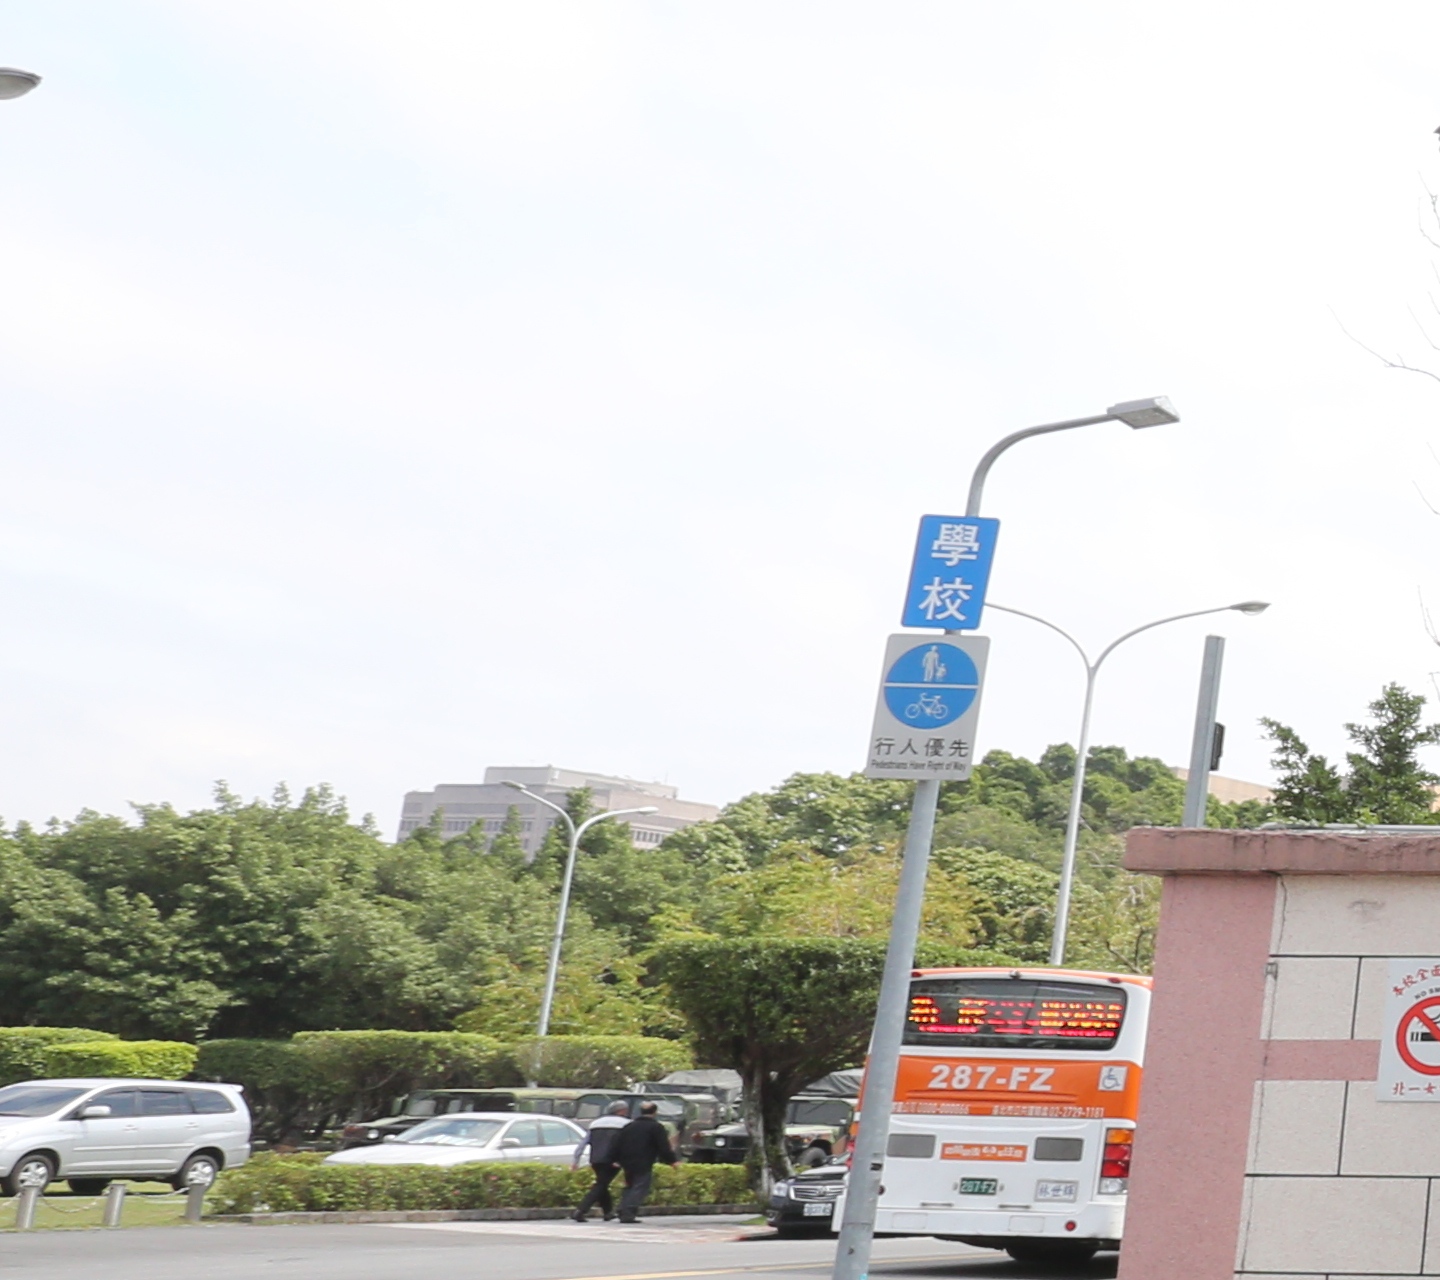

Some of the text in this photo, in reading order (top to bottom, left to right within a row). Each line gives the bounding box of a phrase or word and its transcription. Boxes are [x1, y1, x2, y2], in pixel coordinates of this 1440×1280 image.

[918, 523, 980, 621] 學校
[875, 737, 969, 758] 行人優先
[1414, 991, 1428, 1001] NO
[928, 1064, 1056, 1093] 287-FZ
[961, 1178, 996, 1195] 287-FZ
